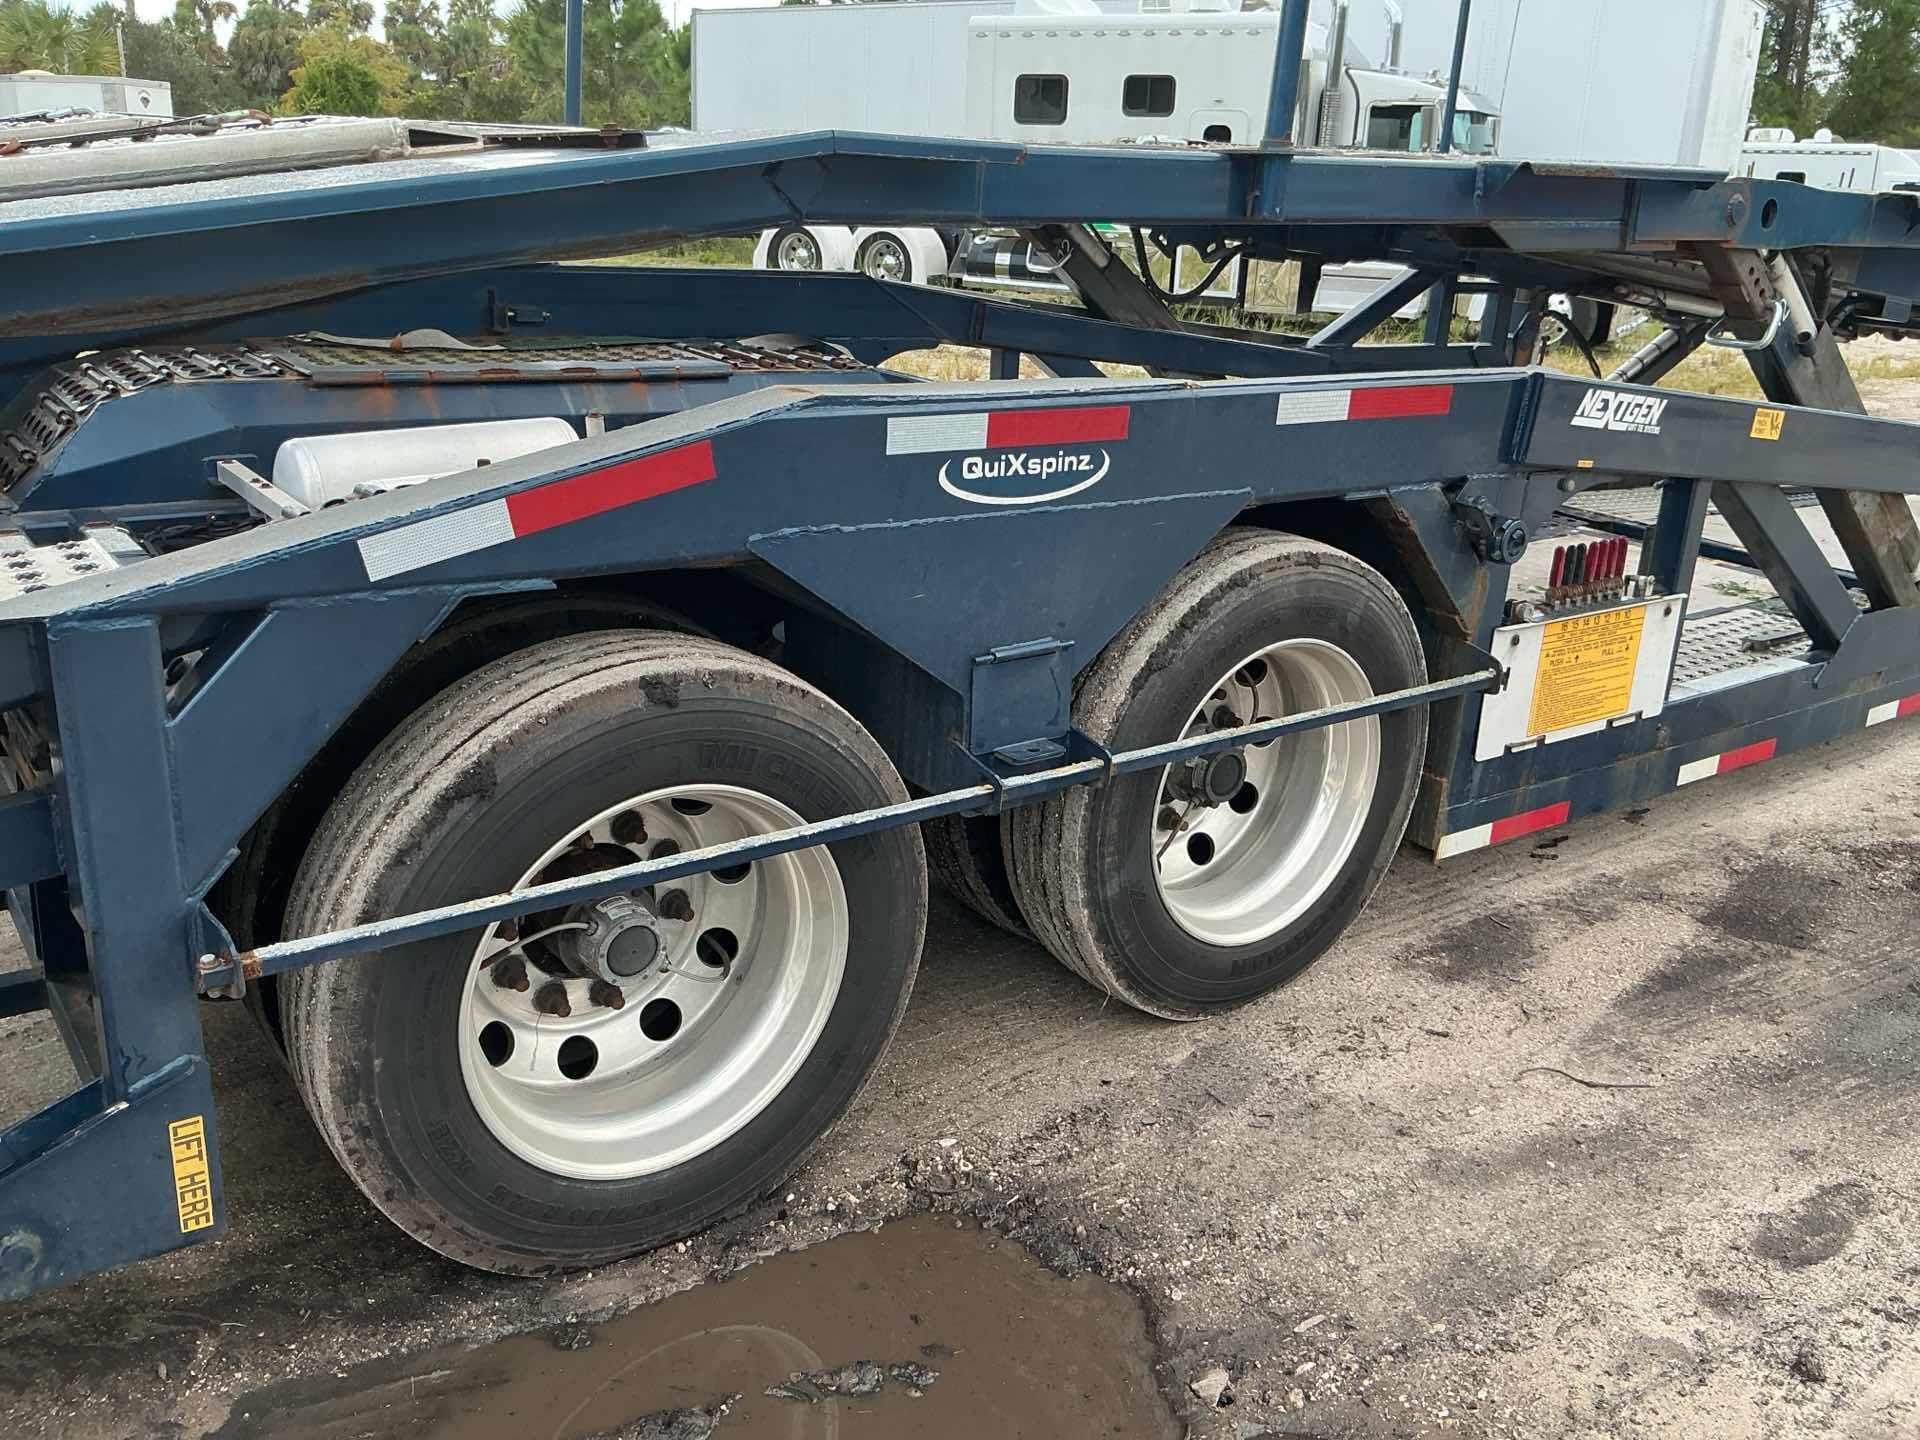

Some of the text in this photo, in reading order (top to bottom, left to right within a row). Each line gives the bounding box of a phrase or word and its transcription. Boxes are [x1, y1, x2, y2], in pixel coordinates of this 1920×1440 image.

[1573, 388, 1668, 430] NEXTGEN
[172, 1120, 211, 1230] LIFT HERE
